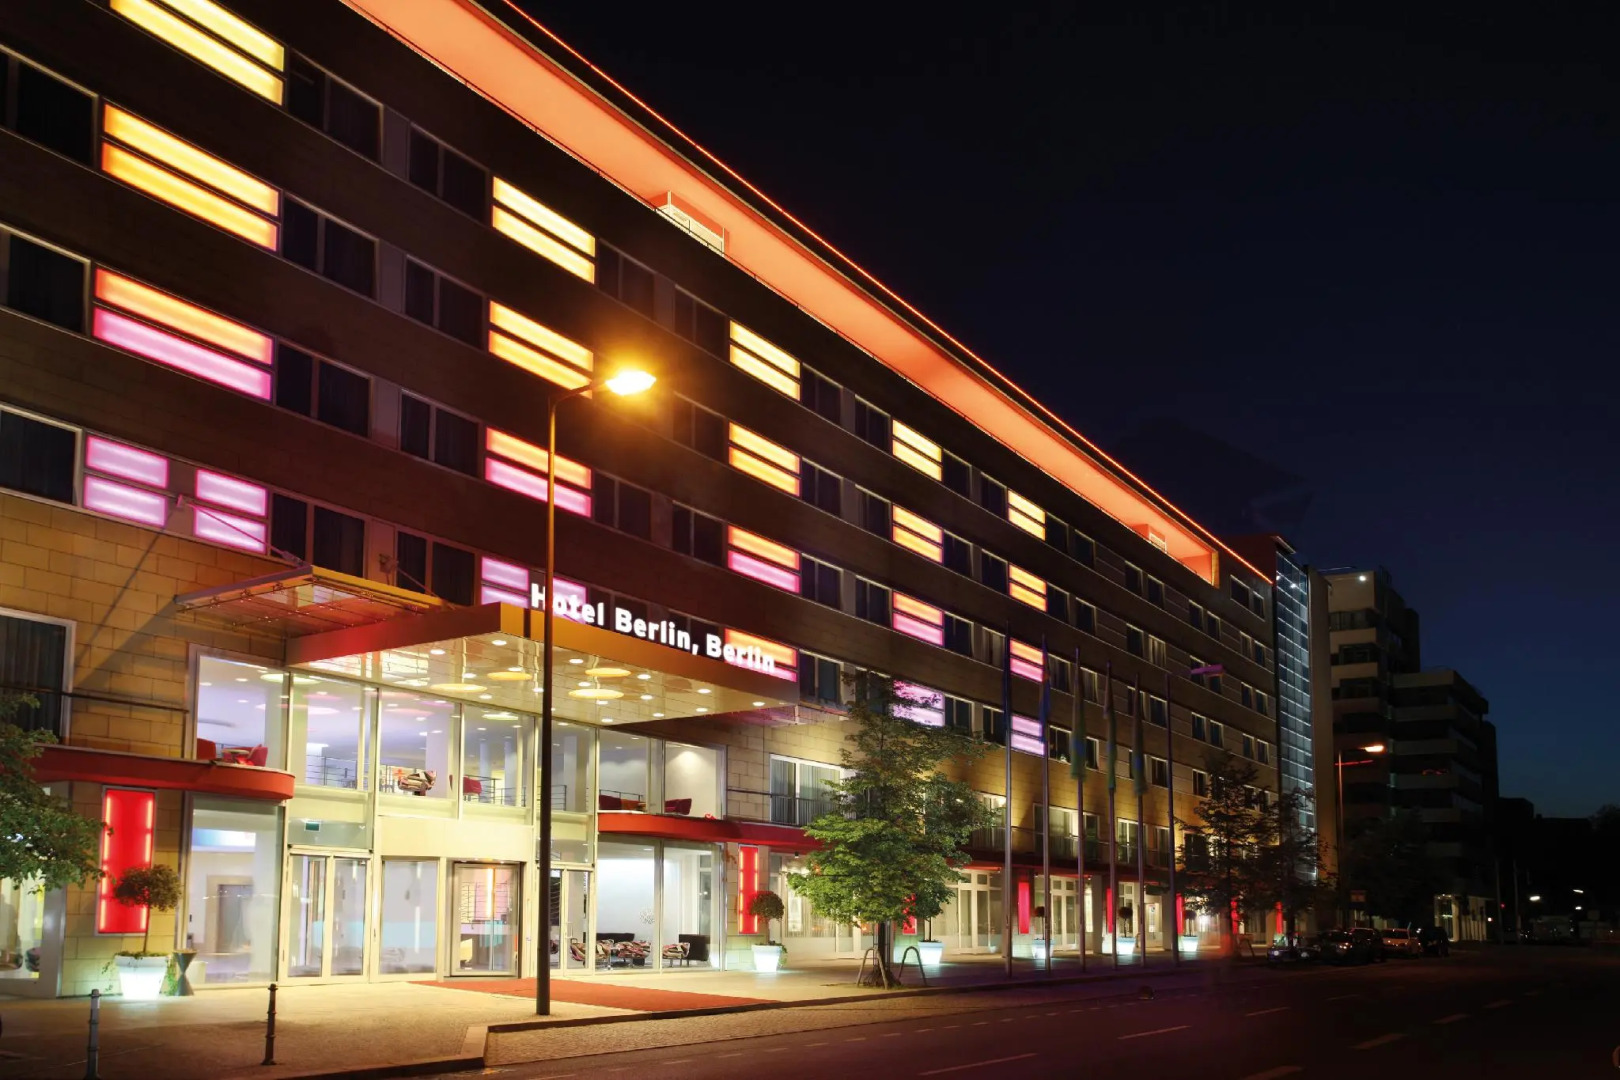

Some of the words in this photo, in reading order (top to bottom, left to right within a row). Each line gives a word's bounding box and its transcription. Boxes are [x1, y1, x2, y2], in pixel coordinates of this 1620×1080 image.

[530, 583, 605, 626] Hotel
[615, 607, 699, 655] Berlin,
[706, 633, 775, 673] Berlin
